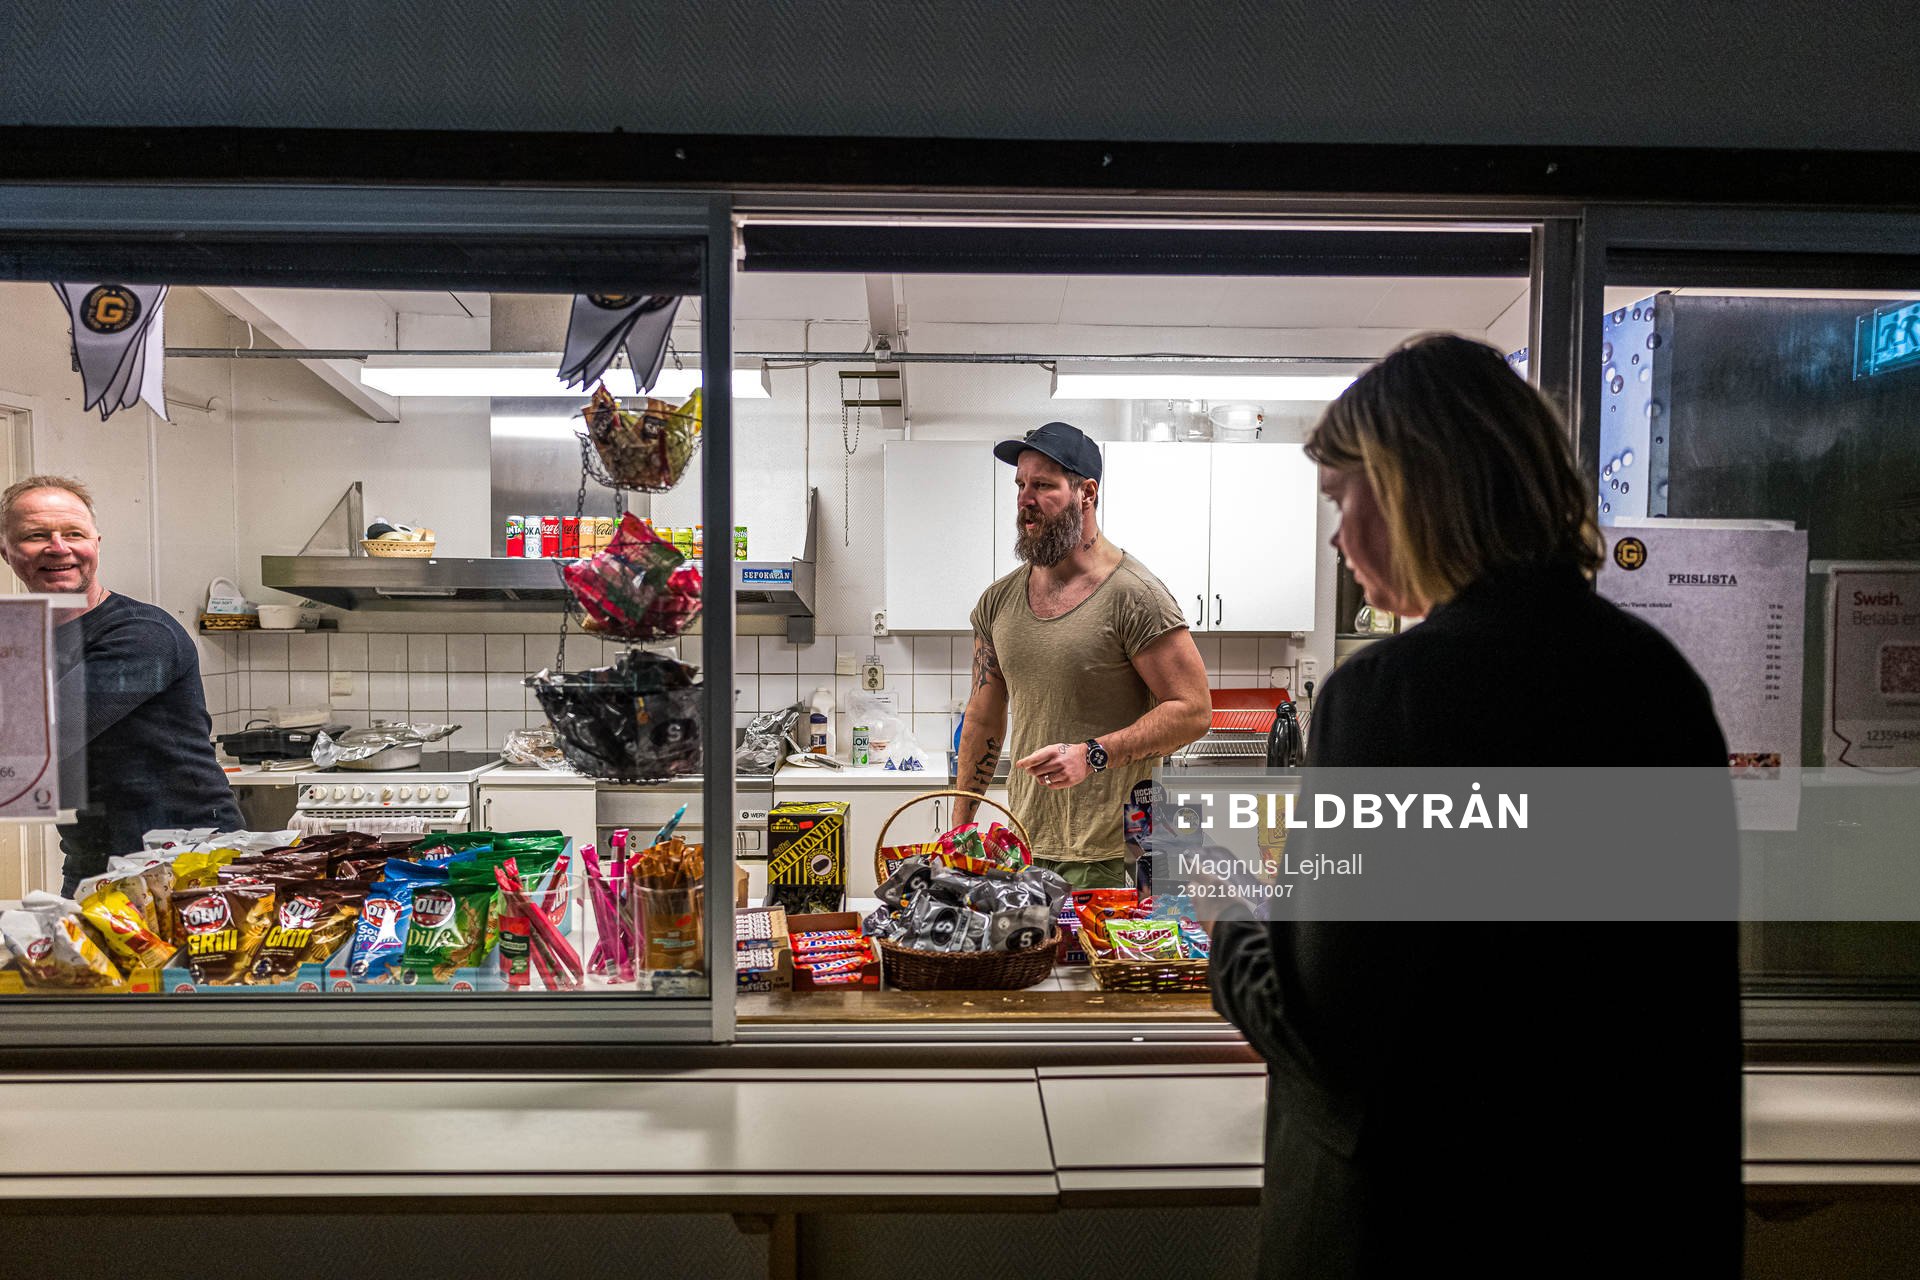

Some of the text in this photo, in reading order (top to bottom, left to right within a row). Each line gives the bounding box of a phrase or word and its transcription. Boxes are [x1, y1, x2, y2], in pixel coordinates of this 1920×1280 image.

[96, 296, 126, 324] G
[1667, 574, 1738, 585] PRISLISTA
[769, 817, 839, 876] PATRONER
[189, 905, 225, 926] OLW
[415, 899, 451, 915] OLW
